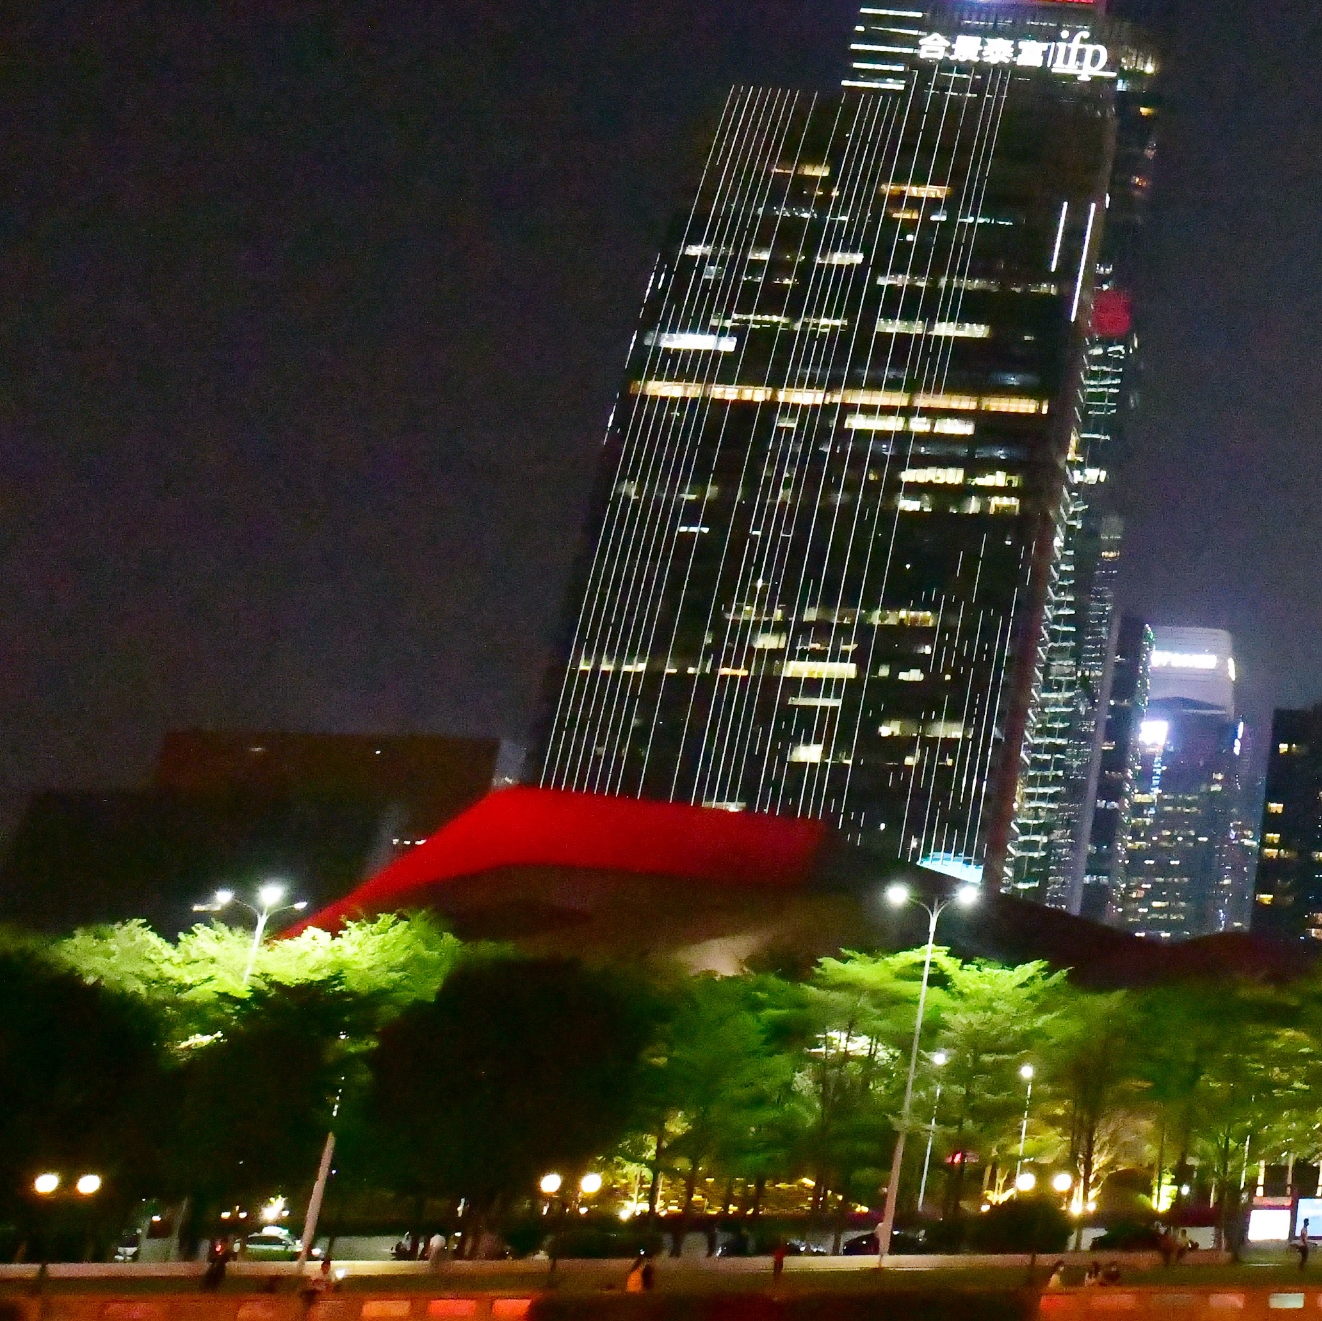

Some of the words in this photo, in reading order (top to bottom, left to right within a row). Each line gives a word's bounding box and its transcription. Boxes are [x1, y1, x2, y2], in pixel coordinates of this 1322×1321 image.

[919, 32, 1048, 67] 合景泰富
[1053, 30, 1109, 81] ifp
